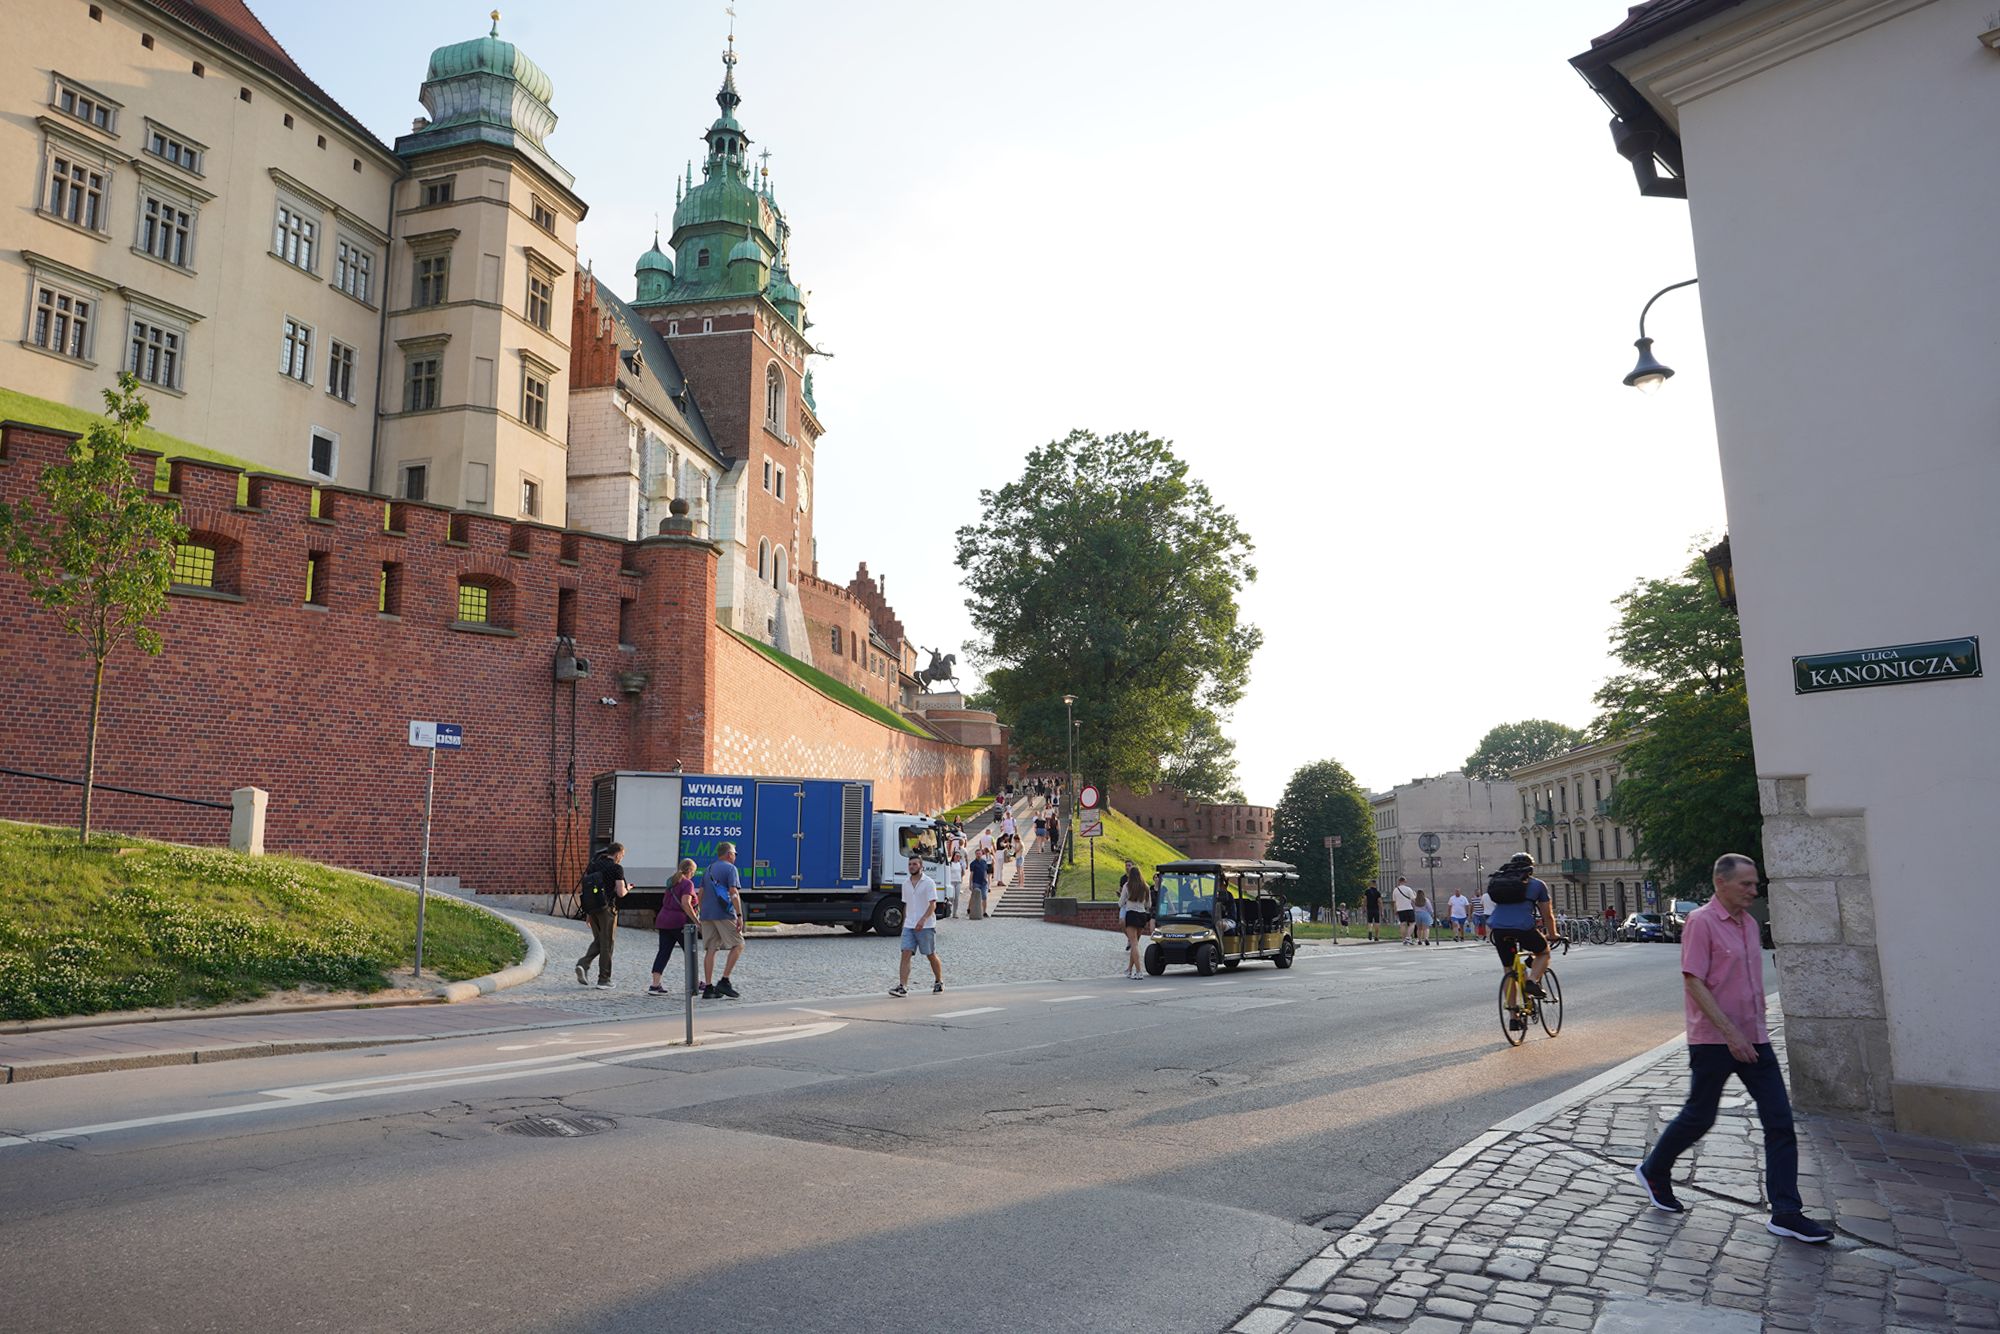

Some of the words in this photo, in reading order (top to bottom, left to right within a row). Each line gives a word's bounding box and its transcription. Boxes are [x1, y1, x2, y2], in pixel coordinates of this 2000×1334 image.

[1861, 650, 1899, 662] ULICA
[1809, 656, 1959, 687] KANONICZA
[687, 783, 743, 795] WYNAJEM
[681, 796, 743, 808] GREGATÓW
[681, 826, 701, 836] 516
[703, 826, 721, 836] 125
[723, 827, 742, 837] 505
[1646, 881, 1653, 889] P
